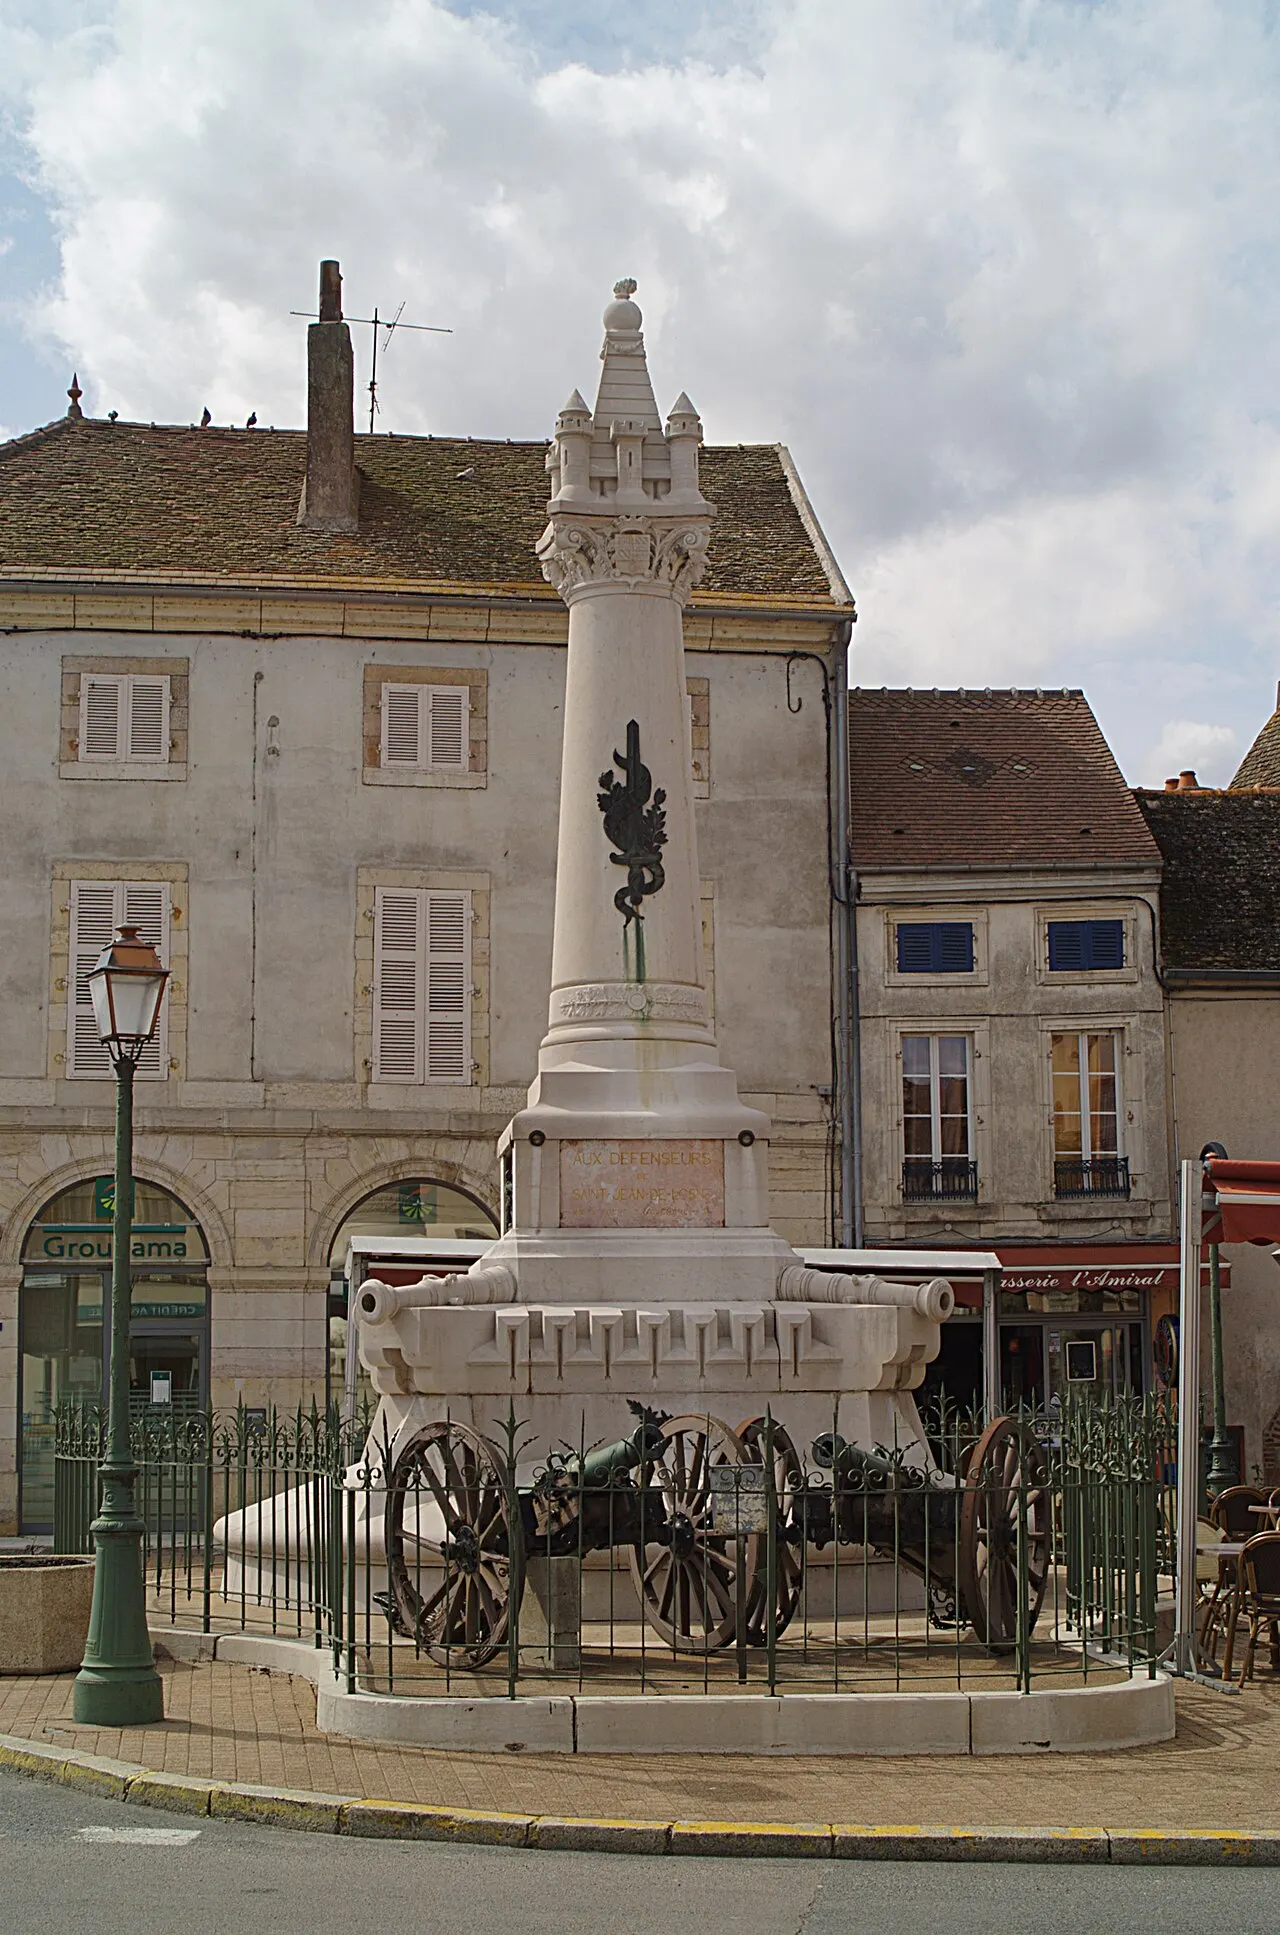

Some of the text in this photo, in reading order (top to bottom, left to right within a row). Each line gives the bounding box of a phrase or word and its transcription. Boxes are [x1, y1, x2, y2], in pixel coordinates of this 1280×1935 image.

[573, 1151, 602, 1165] AUX
[43, 1236, 187, 1258] Grouama
[1071, 1270, 1165, 1287] l'Amiral
